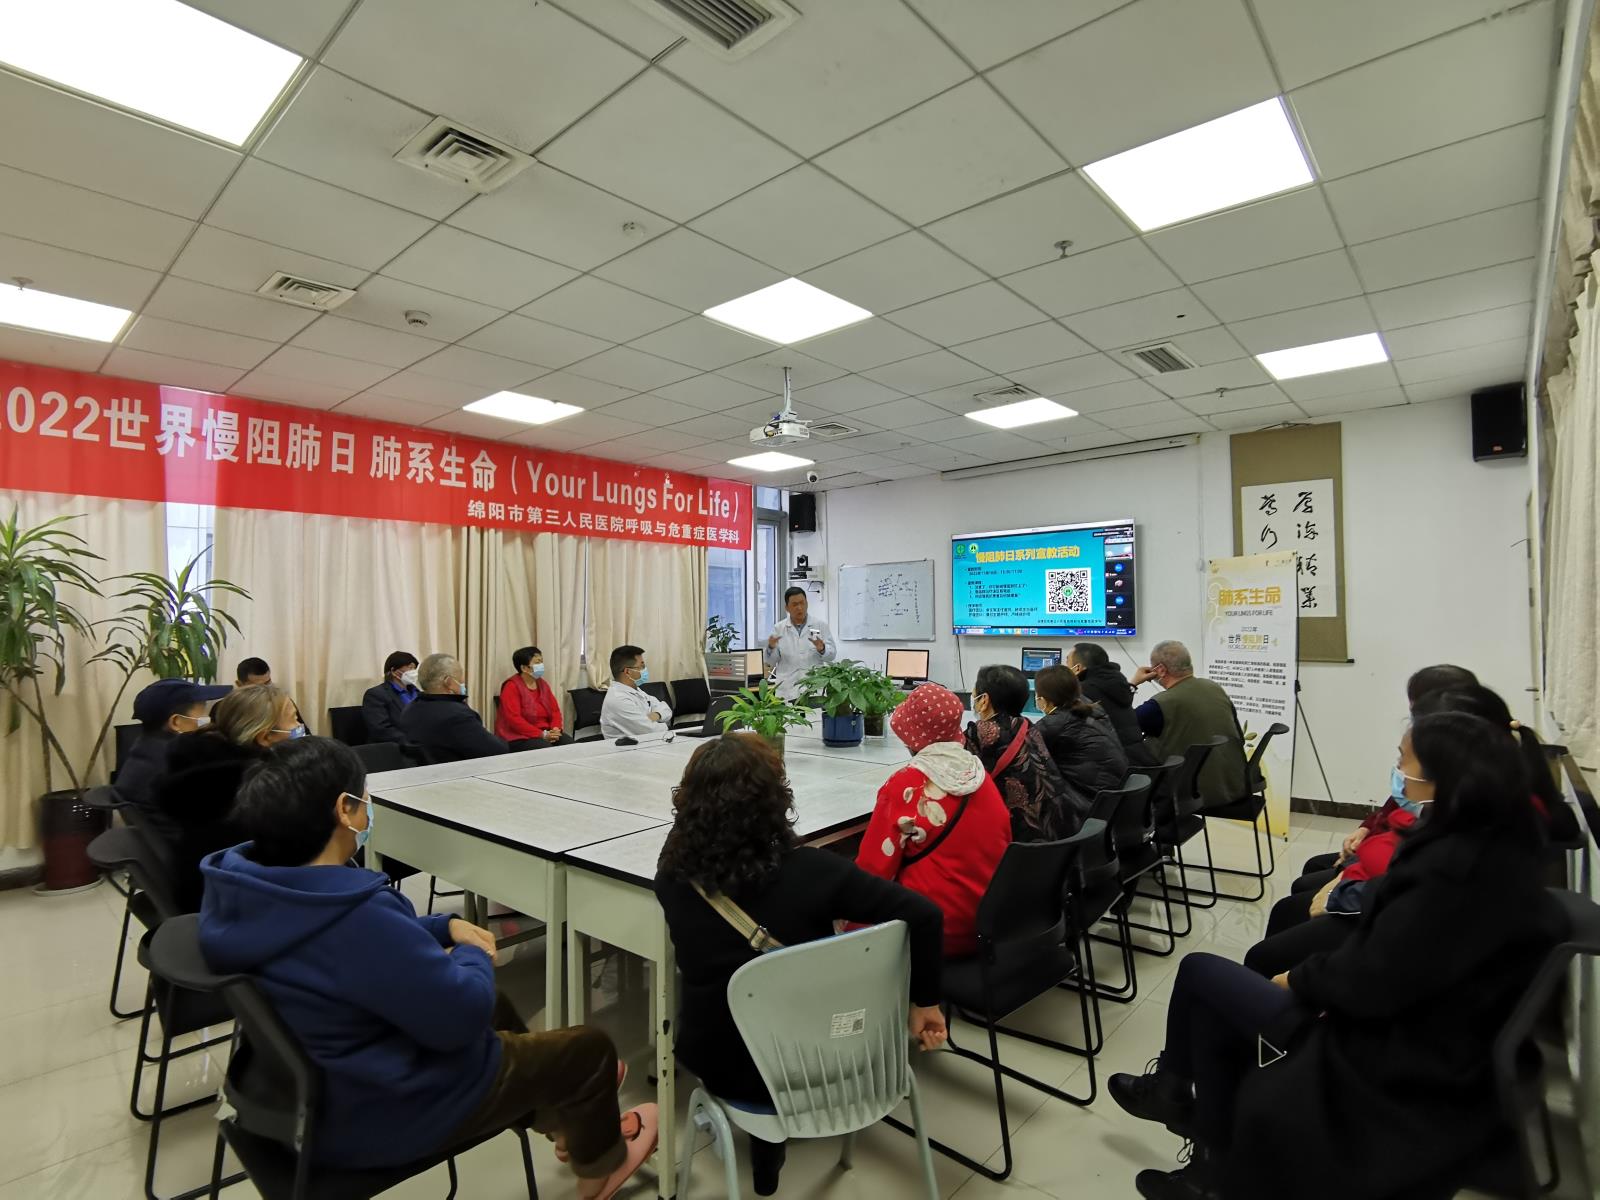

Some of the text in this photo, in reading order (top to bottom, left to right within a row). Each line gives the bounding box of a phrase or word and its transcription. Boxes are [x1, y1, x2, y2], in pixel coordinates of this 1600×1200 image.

[0, 386, 355, 474] 022世界慢阻肺日
[369, 434, 498, 492] 肺系生命
[592, 471, 657, 514] Lungs
[663, 480, 693, 513] For
[467, 499, 740, 545] 绵阳市第三人民医院呼吸与危重症医学科
[1218, 586, 1281, 606] 肺系生命
